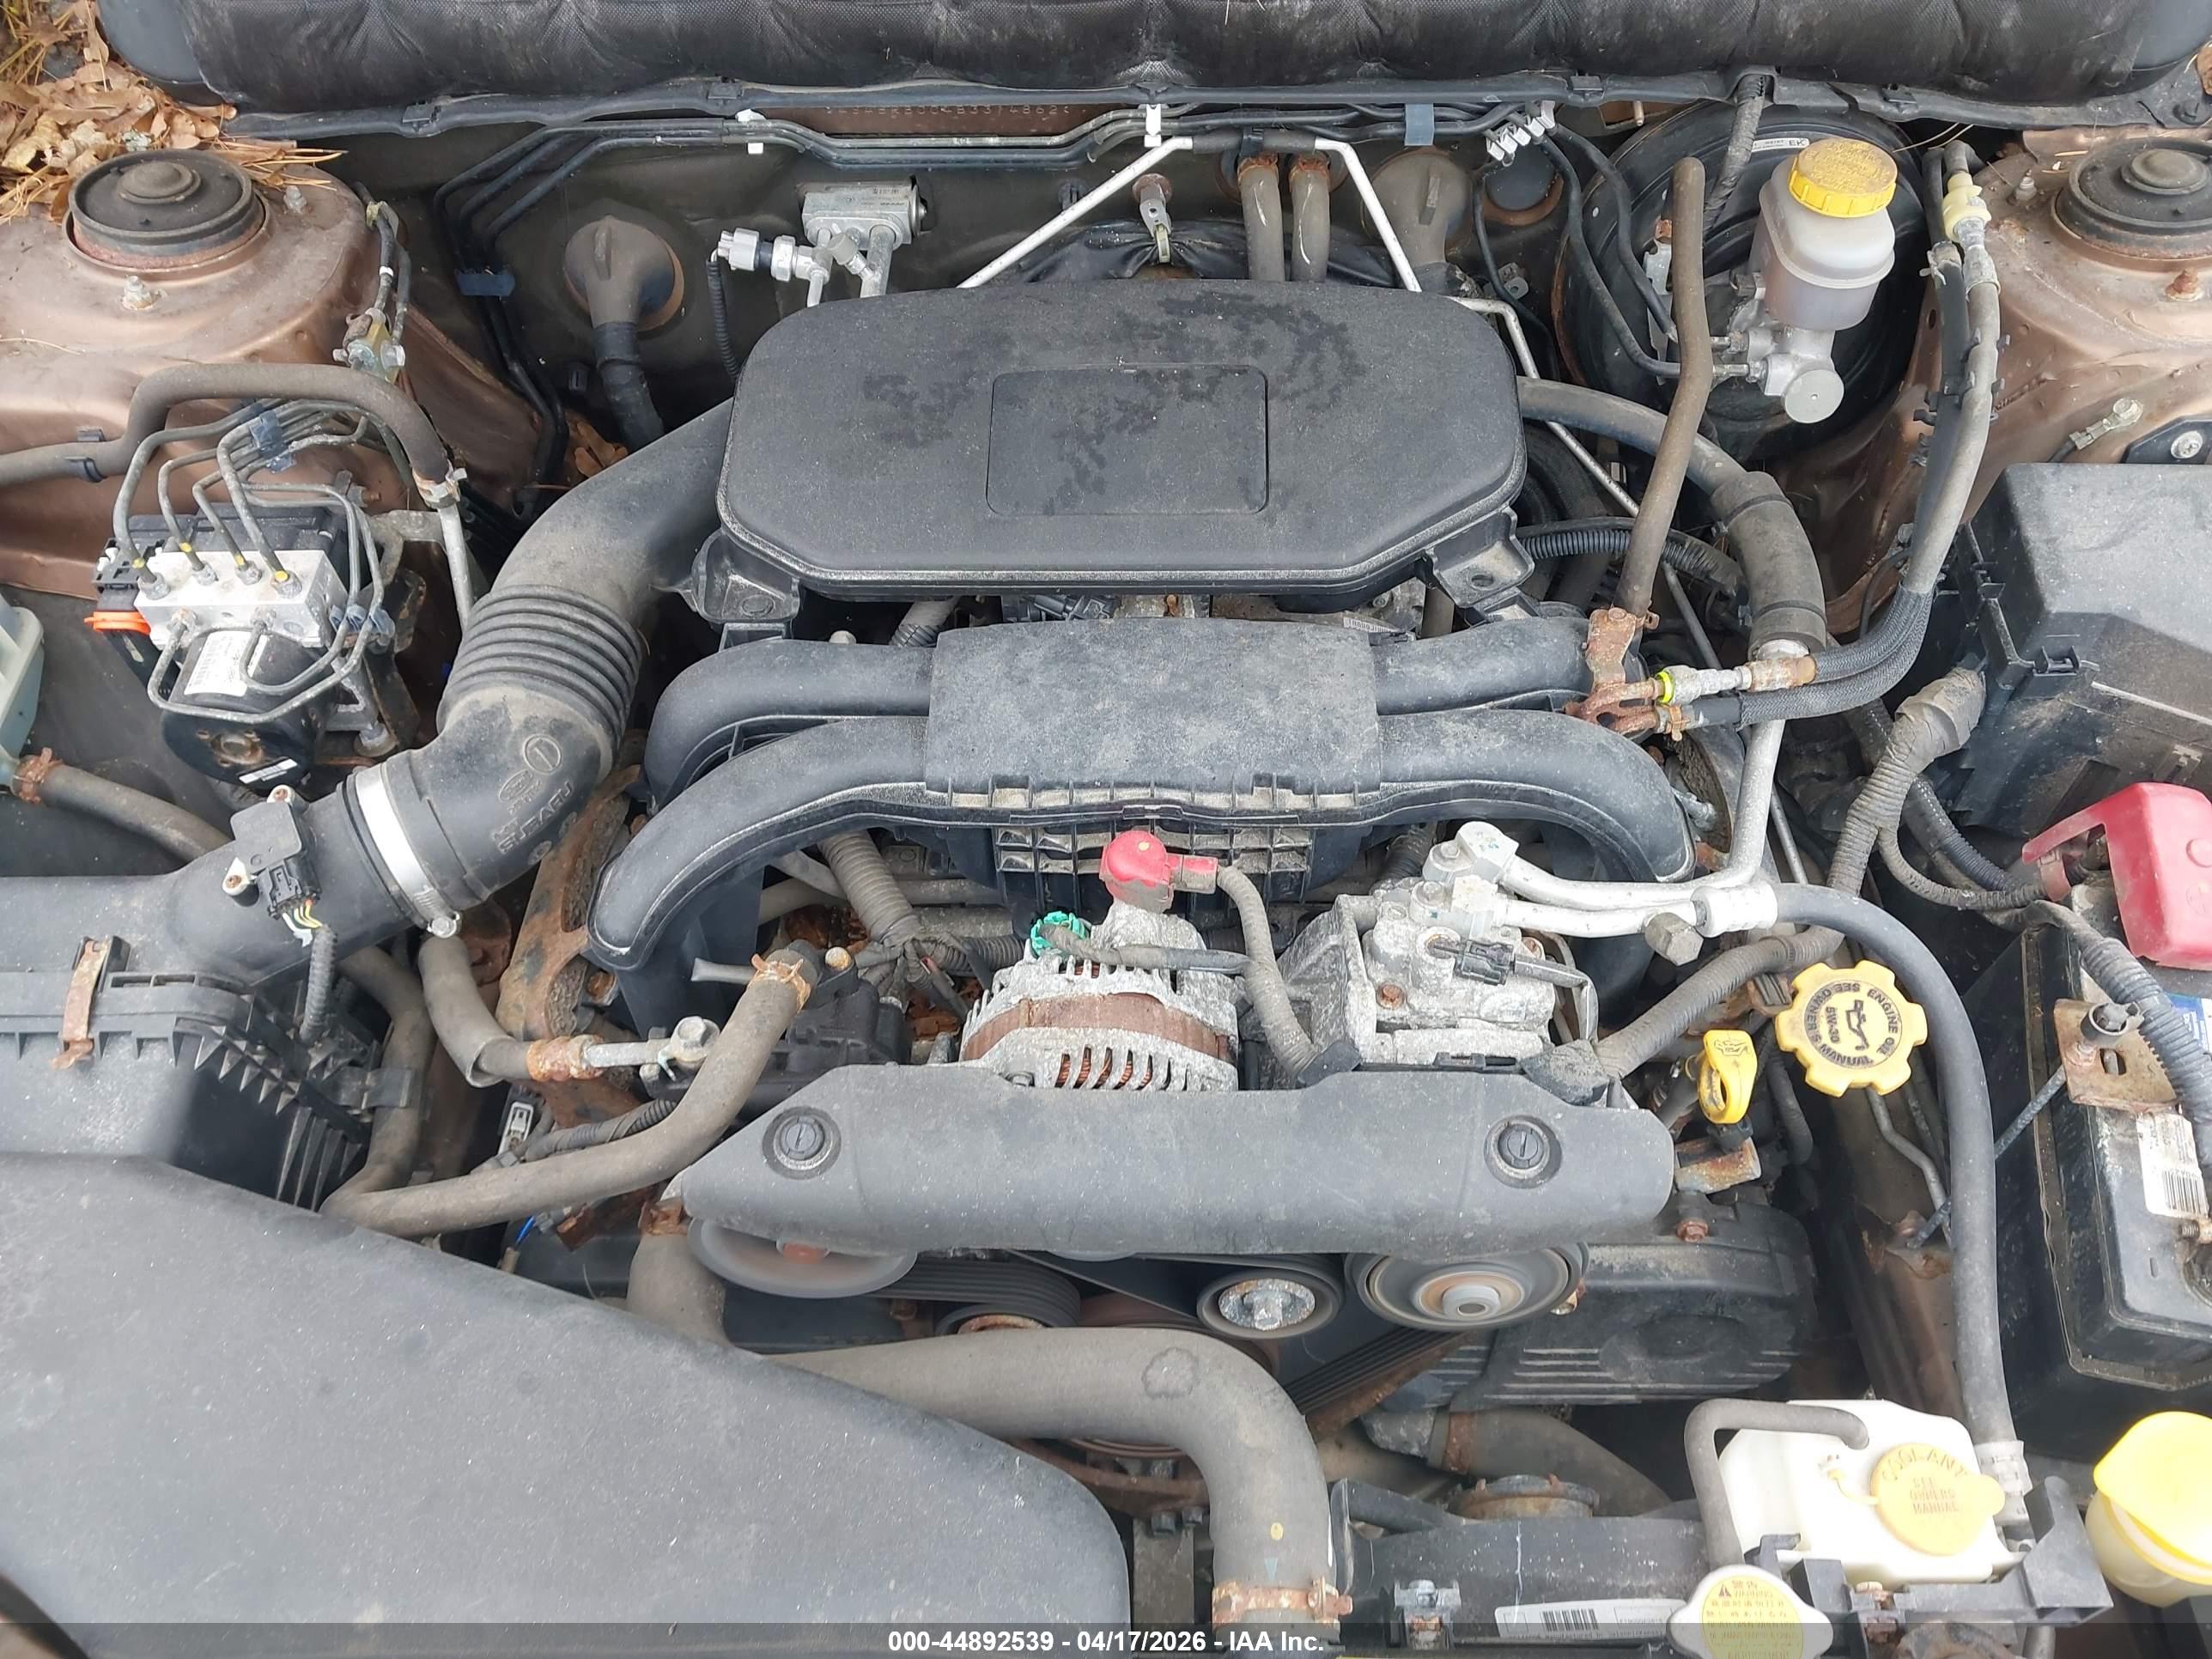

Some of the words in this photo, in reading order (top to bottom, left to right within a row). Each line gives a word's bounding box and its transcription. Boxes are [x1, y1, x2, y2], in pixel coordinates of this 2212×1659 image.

[1834, 983, 1861, 993] SEE
[1867, 988, 1898, 1034] ENGINE
[1826, 1007, 1841, 1043] 5W-30
[1820, 1043, 1875, 1066] MANUAL
[1875, 1037, 1895, 1055] OIL
[1881, 1449, 1968, 1481] COOLANT
[1913, 1477, 1936, 1489] SEE
[1911, 1502, 1959, 1515] MANUAL
